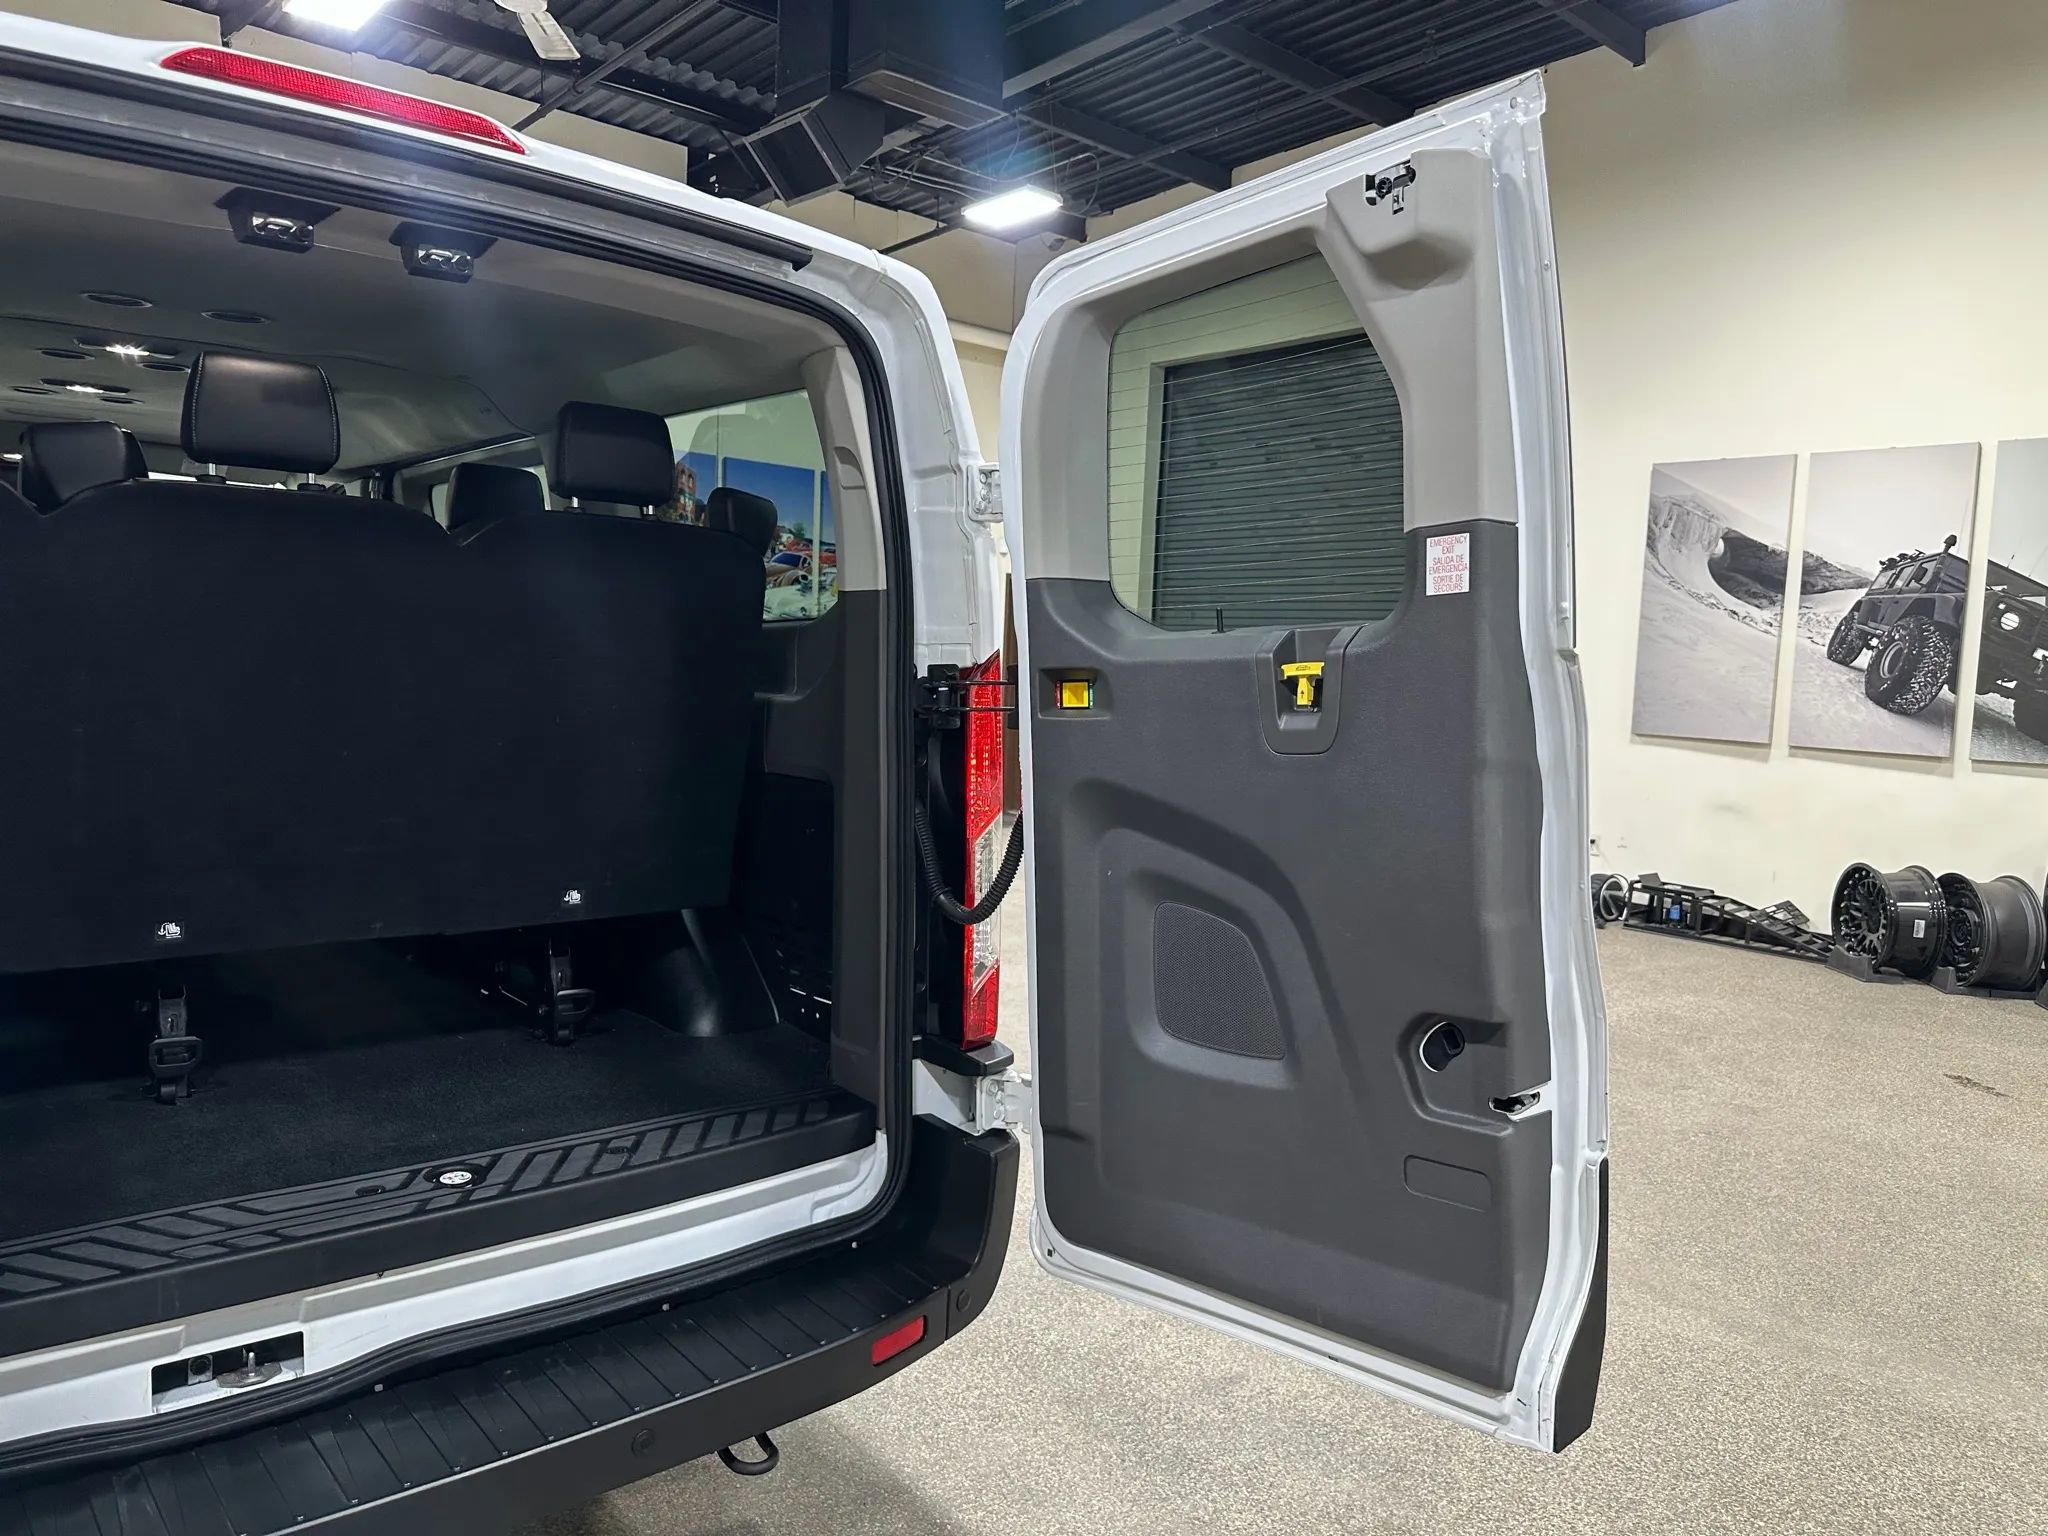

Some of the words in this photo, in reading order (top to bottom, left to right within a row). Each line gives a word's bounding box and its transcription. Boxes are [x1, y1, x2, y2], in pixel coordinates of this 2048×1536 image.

[1430, 534, 1467, 548] EMERGENCY
[1442, 545, 1454, 554] EXIT
[1432, 556, 1454, 566] SALIDA
[1456, 554, 1464, 562] DE
[1428, 562, 1468, 575] EMERGENCIA
[1432, 574, 1454, 585] SORTIE
[1455, 574, 1464, 582] DE
[1434, 582, 1462, 593] SECOURS
